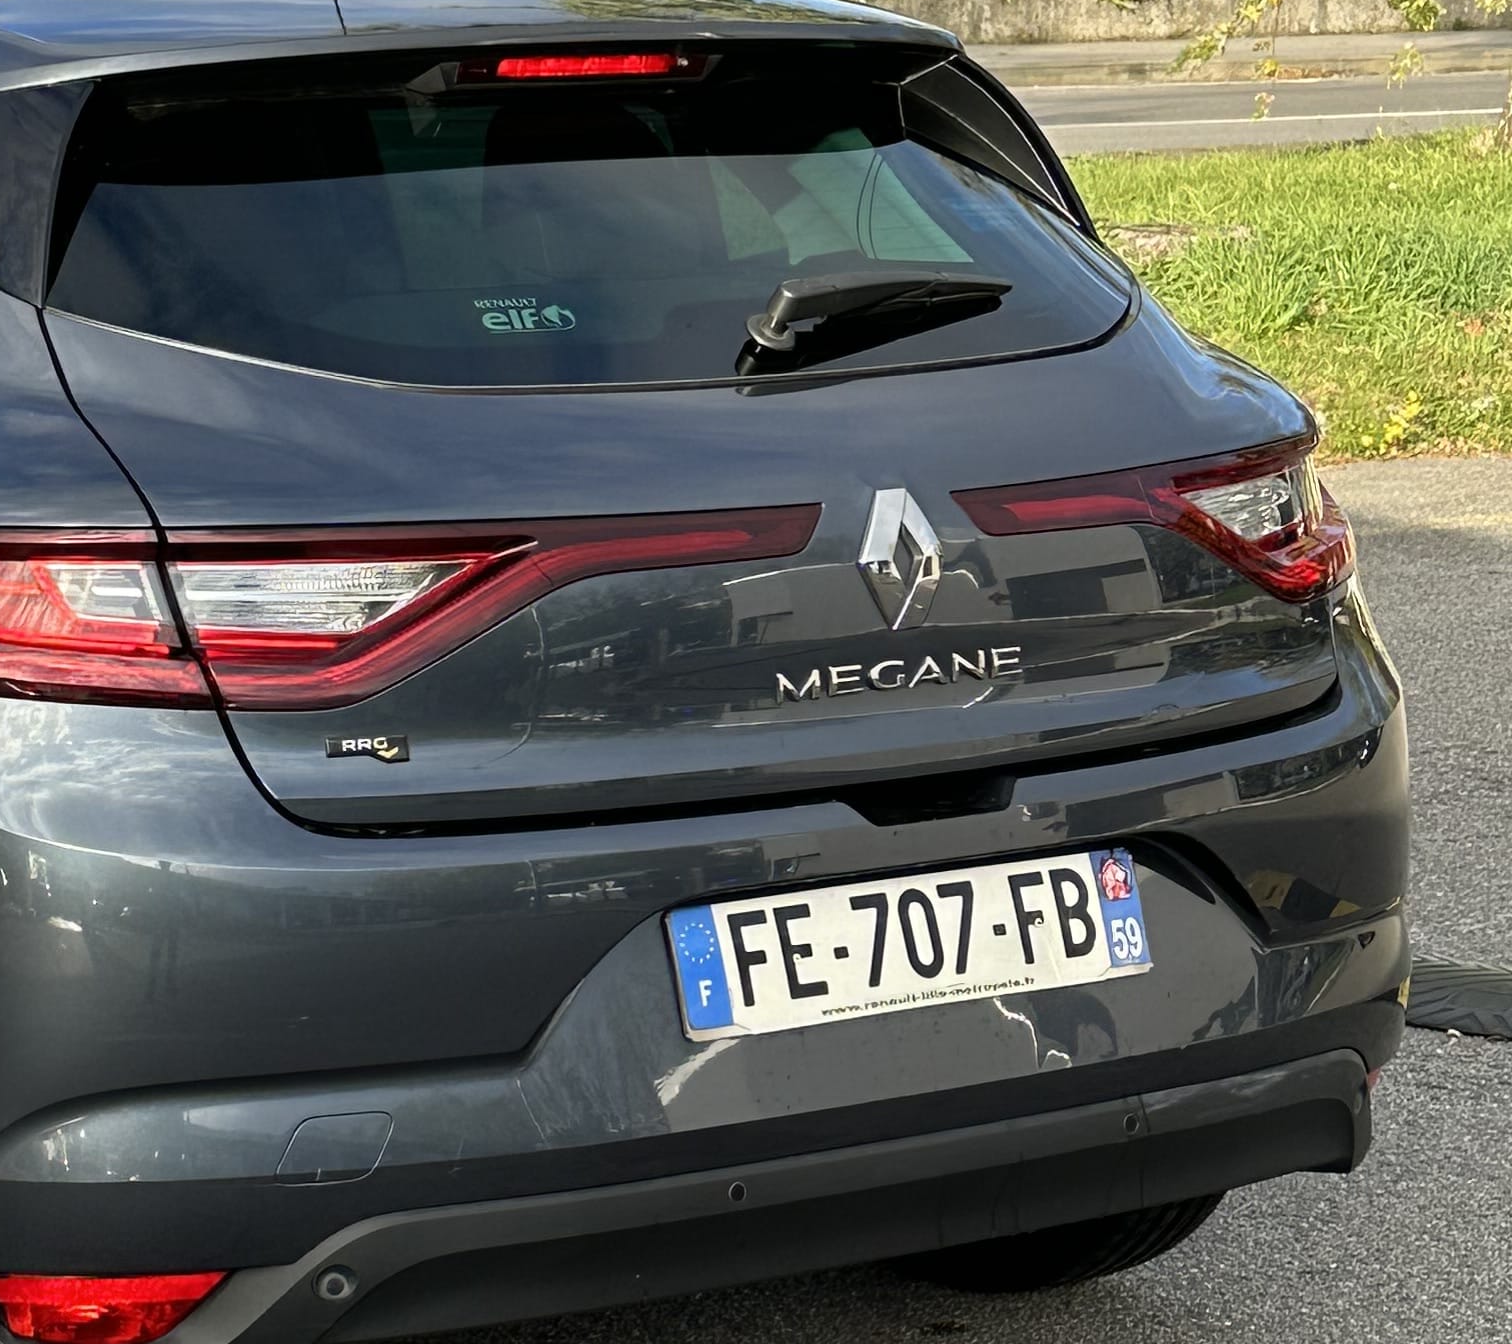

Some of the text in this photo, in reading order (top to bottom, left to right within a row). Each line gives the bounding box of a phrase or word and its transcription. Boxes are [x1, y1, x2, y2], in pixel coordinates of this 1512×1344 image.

[473, 297, 538, 309] RENAULT
[482, 308, 539, 331] elf
[776, 646, 1024, 706] MEGANE
[341, 737, 388, 752] RRG
[1111, 917, 1143, 960] 59
[699, 979, 713, 1007] F
